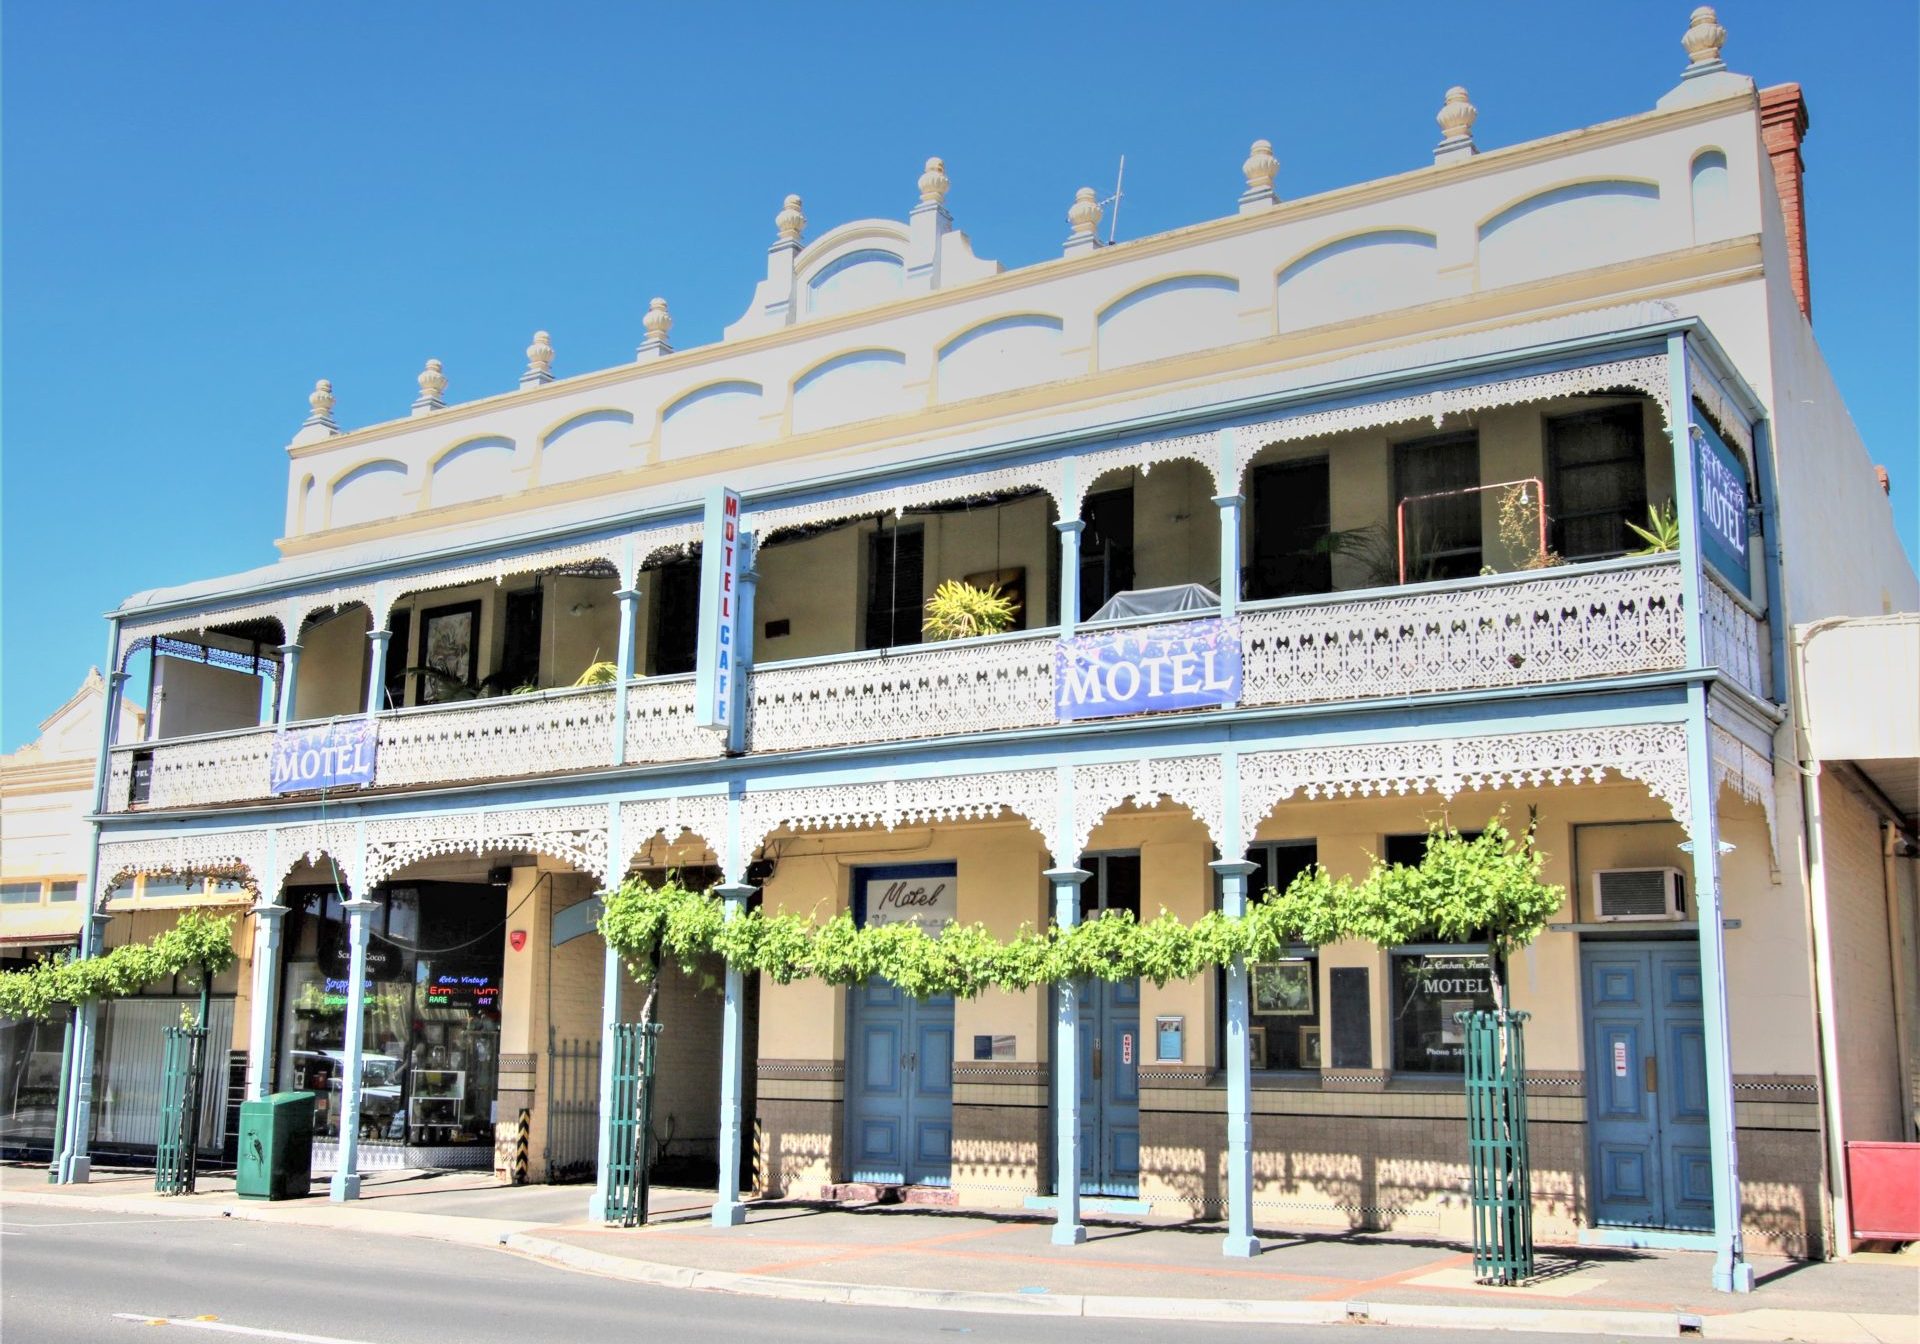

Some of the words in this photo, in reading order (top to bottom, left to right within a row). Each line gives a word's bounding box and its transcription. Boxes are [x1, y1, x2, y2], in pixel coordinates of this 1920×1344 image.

[1703, 472, 1744, 556] MOTEL
[721, 496, 737, 618] MOTEL
[718, 624, 730, 720] CAFE
[1058, 650, 1233, 706] MOTEL
[273, 743, 370, 783] MOTEL
[878, 881, 946, 911] Motel
[439, 975, 458, 984] Retro
[1423, 978, 1489, 993] MOTEL
[429, 996, 448, 1004] RARE
[1426, 1047, 1449, 1056] Phone
